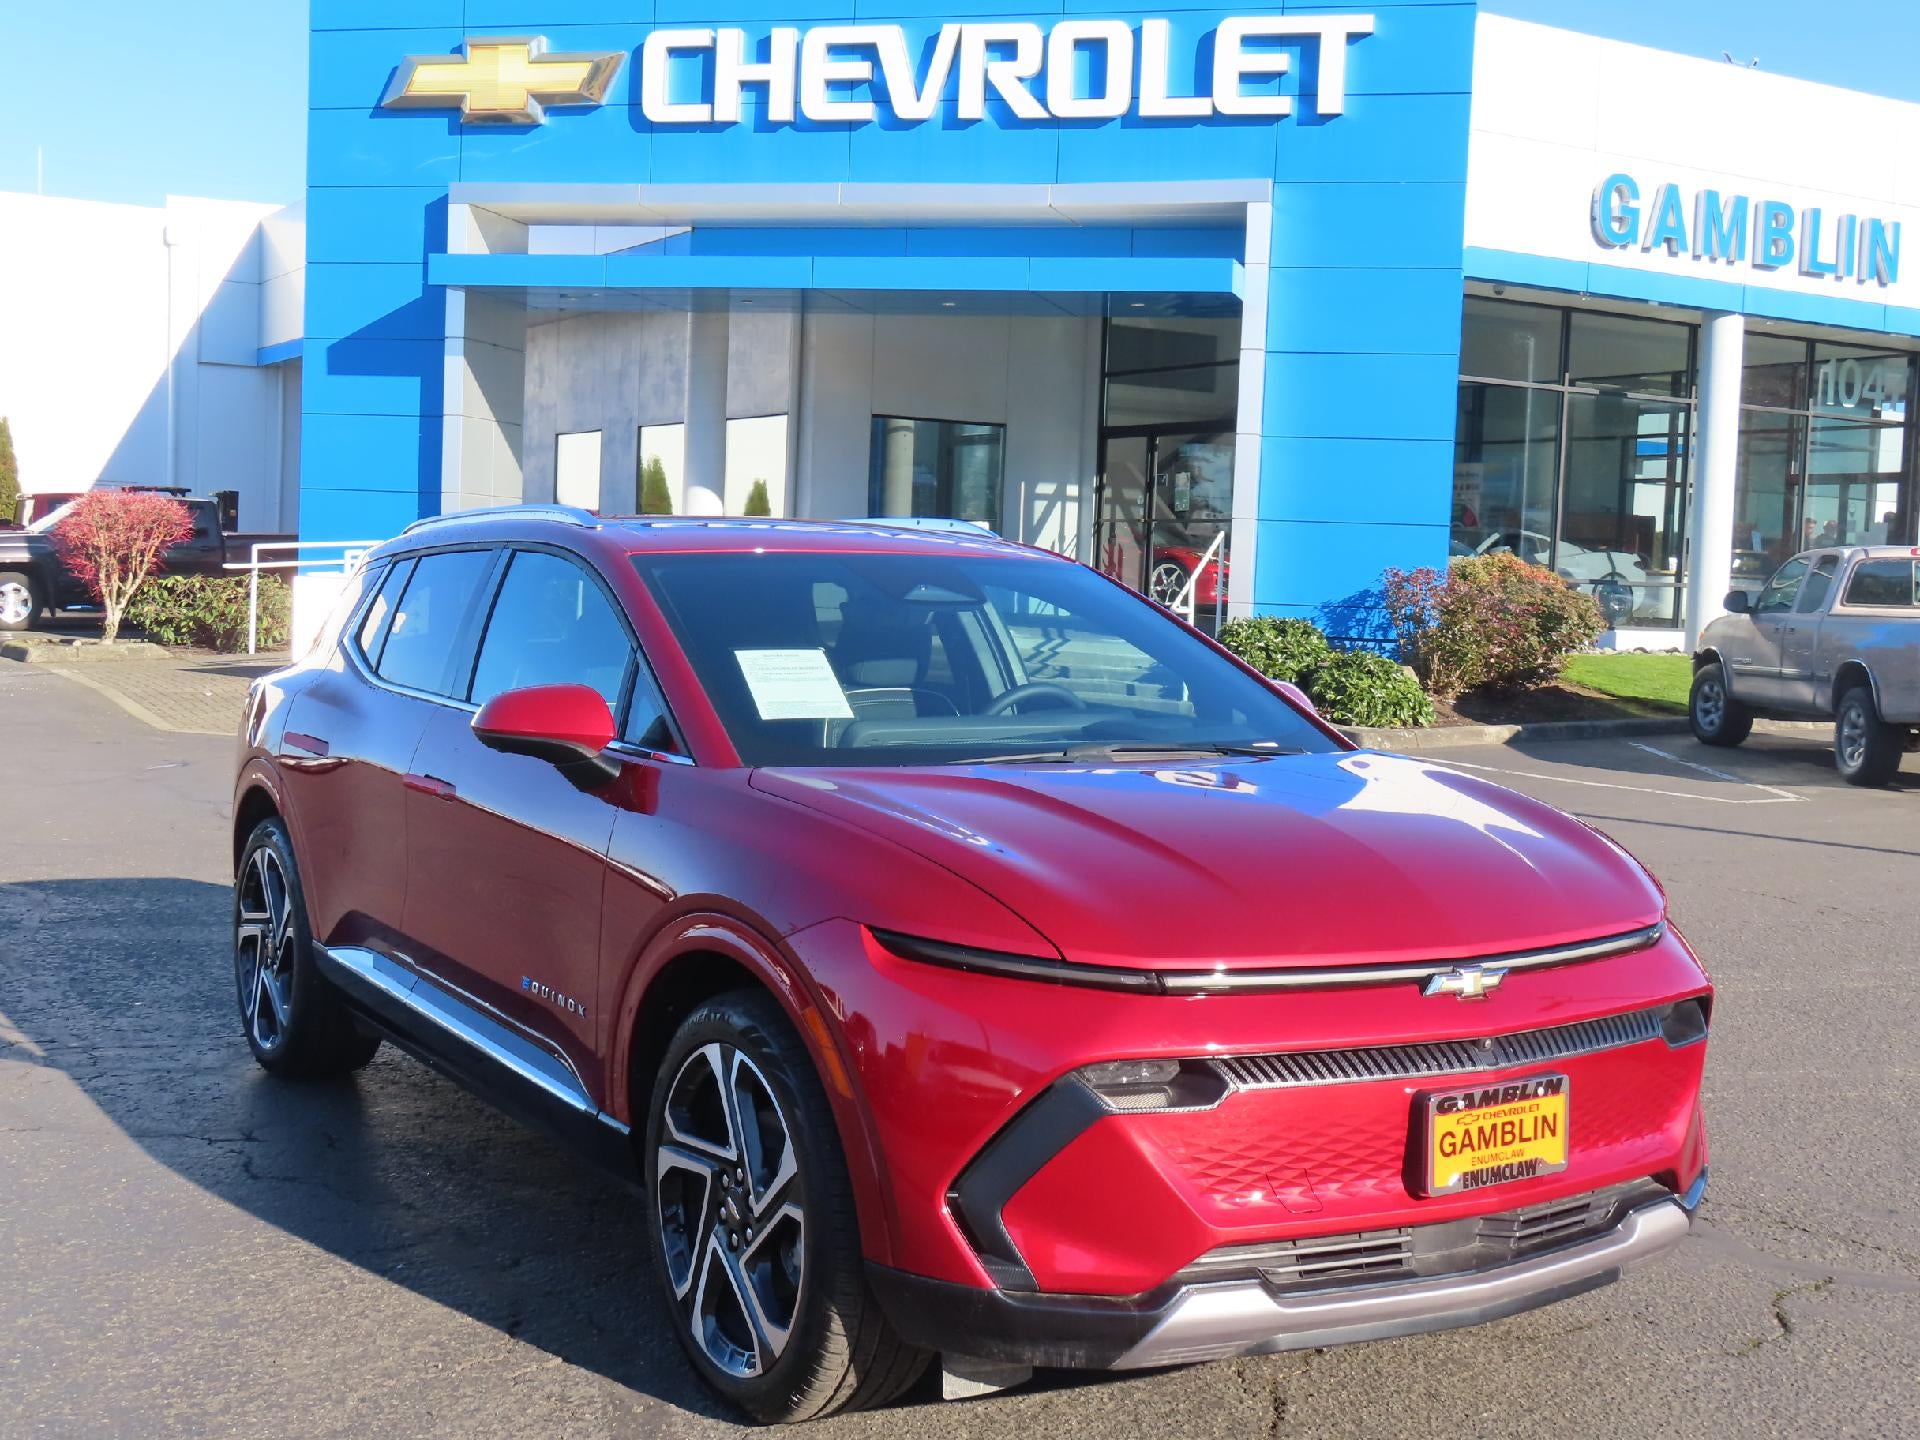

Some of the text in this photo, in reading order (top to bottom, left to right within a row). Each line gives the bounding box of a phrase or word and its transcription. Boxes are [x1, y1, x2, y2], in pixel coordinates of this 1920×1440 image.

[641, 14, 1375, 122] CHEVROLET
[1590, 173, 1901, 287] GAMBLIN
[521, 975, 586, 1018] EQUINOX
[1436, 1077, 1563, 1114] GAMBLIN
[1482, 1103, 1540, 1120] CHEVROLET
[1439, 1112, 1557, 1158] GAMBLIN
[1463, 1159, 1538, 1189] ENUMCLAW
[1471, 1148, 1525, 1166] ENUMCLAW
